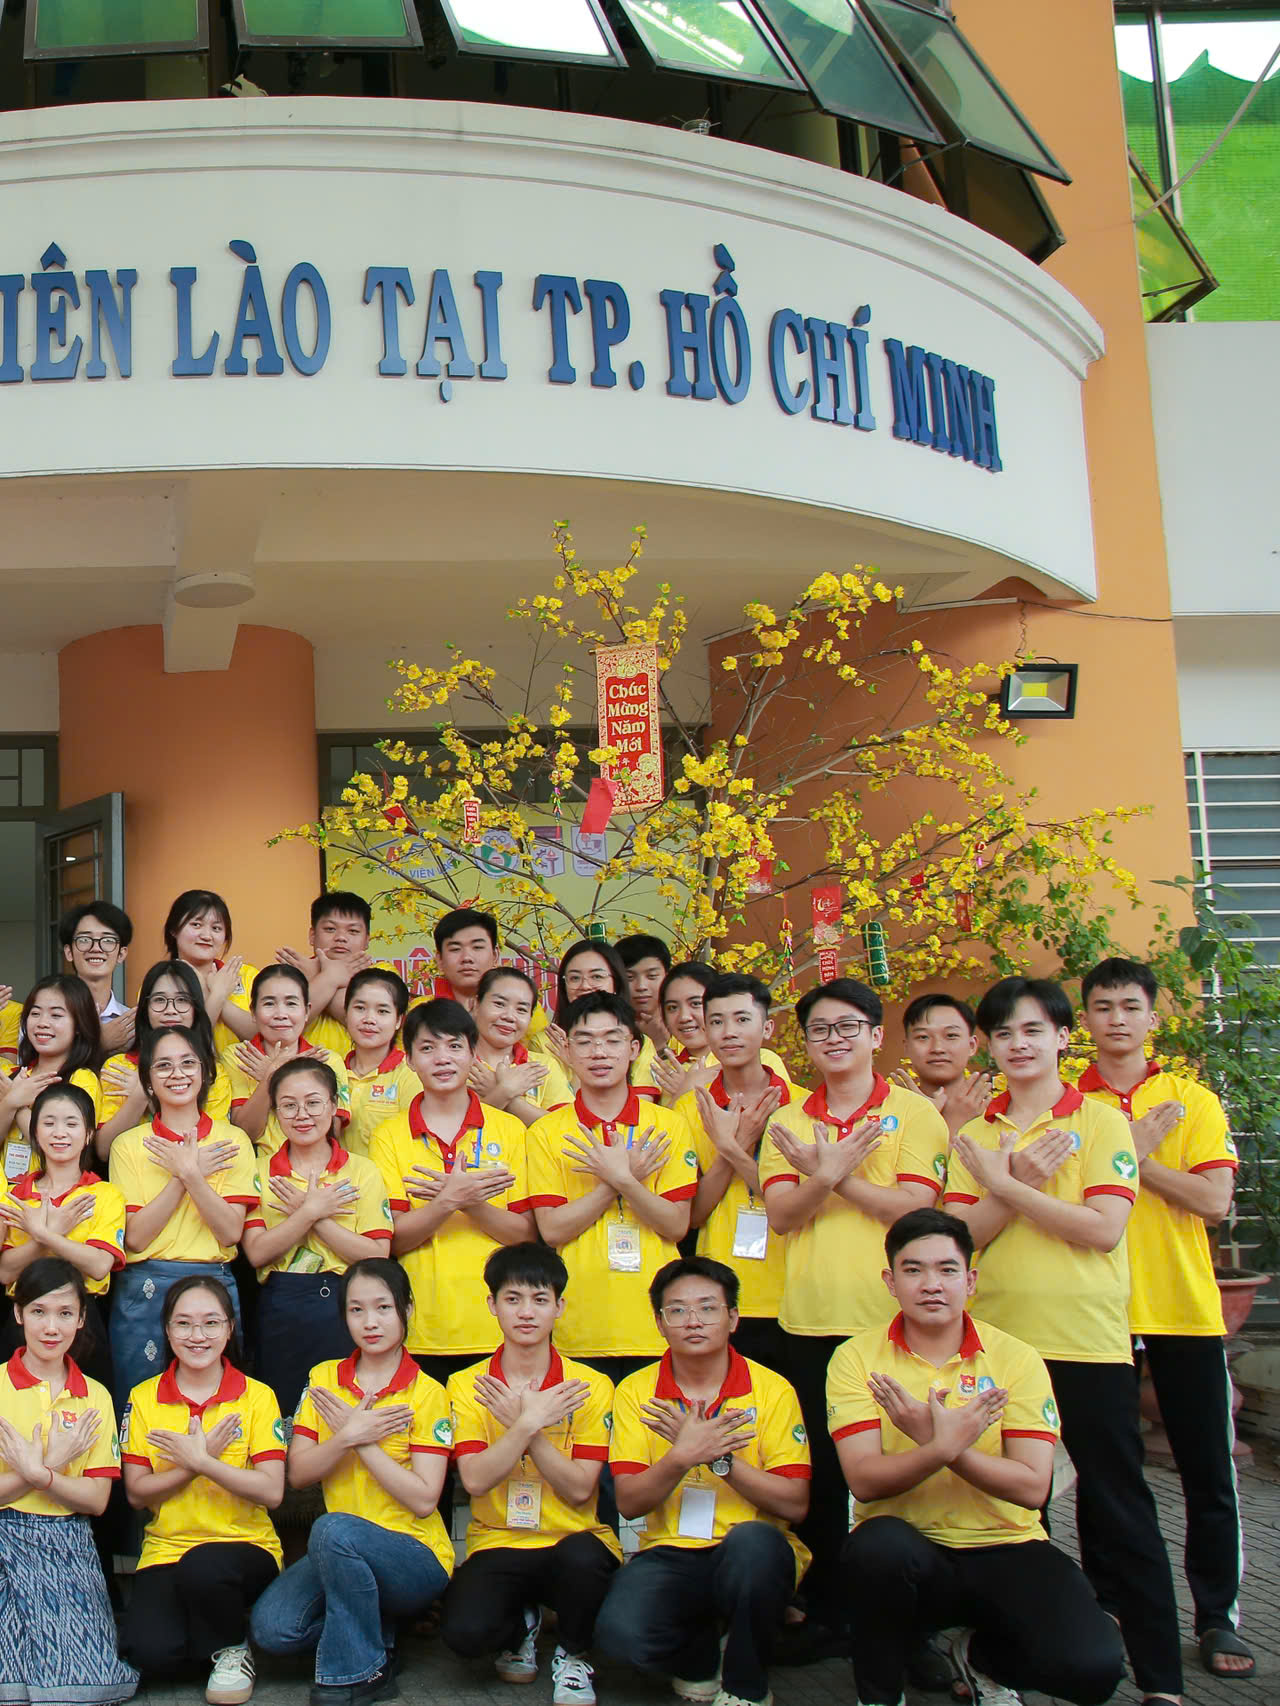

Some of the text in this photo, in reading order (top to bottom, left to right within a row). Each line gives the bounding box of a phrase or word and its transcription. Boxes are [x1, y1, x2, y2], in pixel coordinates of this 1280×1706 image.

[170, 239, 332, 377] LÀO
[364, 265, 508, 402] TẠI
[534, 273, 646, 390] TP.
[659, 243, 752, 405] HỒ
[768, 304, 877, 431] CHÍ
[884, 338, 1004, 473] MINH
[609, 682, 647, 699] Chúc
[607, 701, 649, 718] Mừng
[611, 720, 646, 736] Năm
